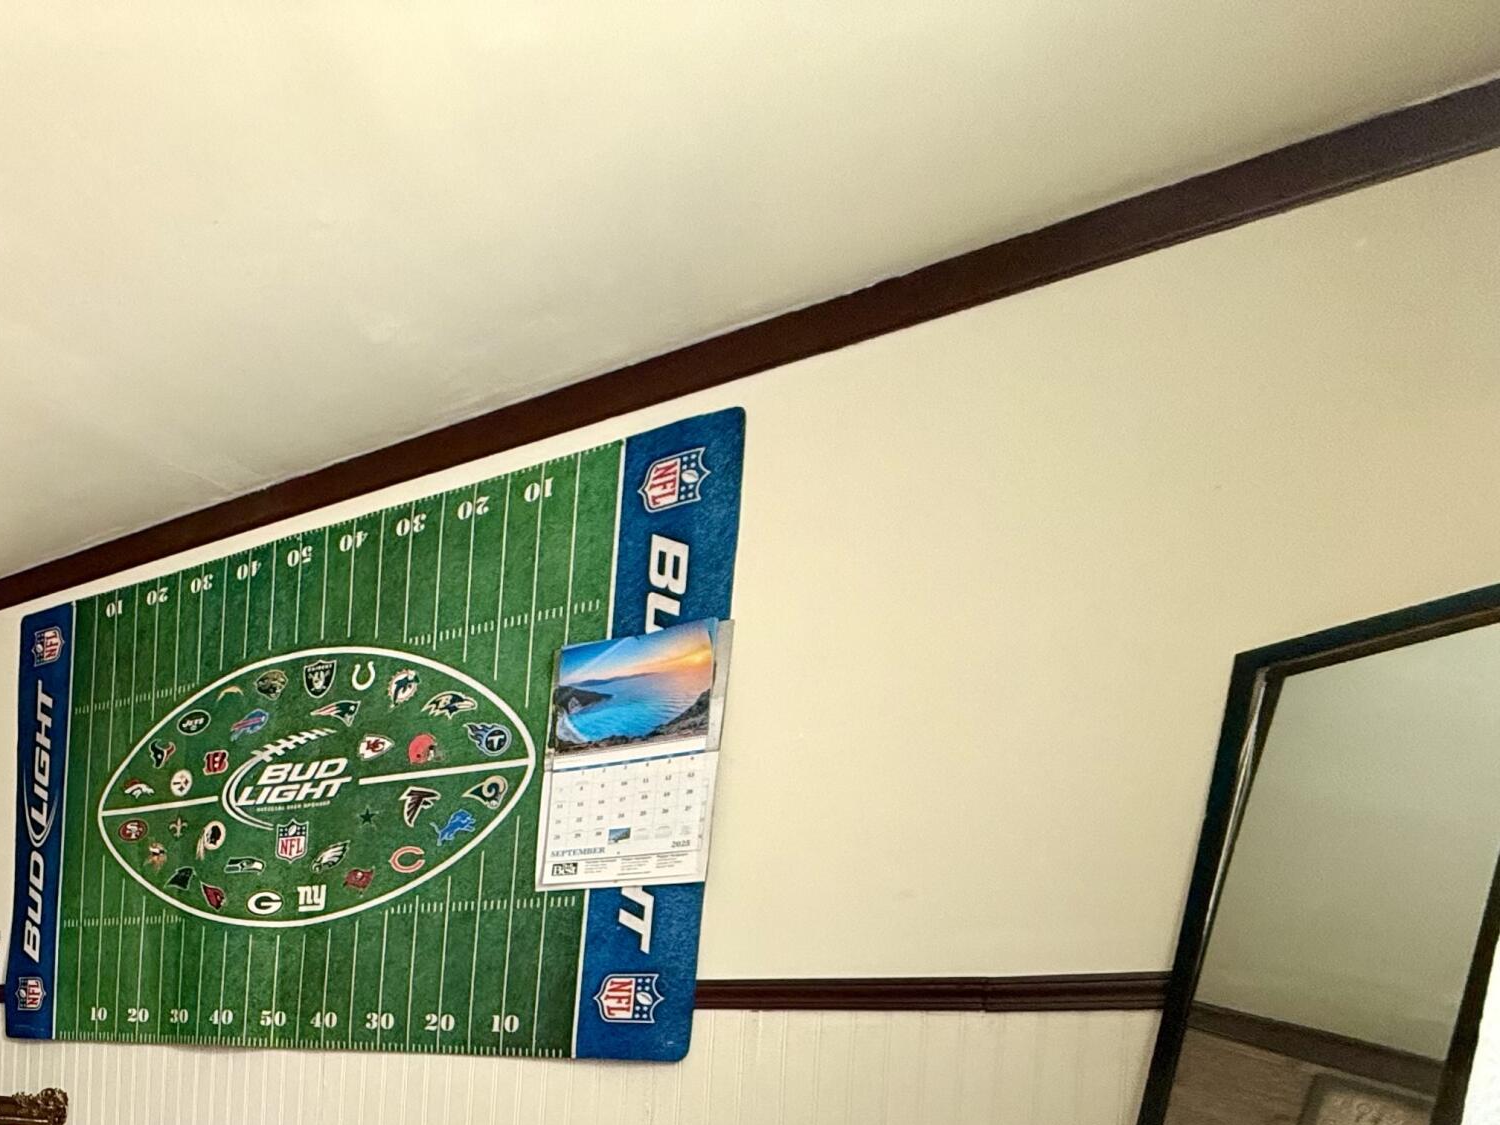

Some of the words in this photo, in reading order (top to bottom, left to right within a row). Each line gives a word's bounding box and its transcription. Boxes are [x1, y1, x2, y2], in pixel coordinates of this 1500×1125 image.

[651, 460, 678, 506] NFL
[106, 599, 123, 618] 10
[147, 586, 169, 605] 20
[190, 574, 213, 593] 30
[237, 560, 262, 581] 40
[287, 545, 313, 567] 50
[339, 530, 368, 552] 40
[396, 513, 427, 536] 30
[457, 496, 490, 520] 20
[523, 477, 554, 502] 10
[45, 631, 59, 658] NFL
[30, 679, 53, 828] LIGHT
[257, 758, 348, 785] BUD
[236, 776, 352, 806] LIGHT
[280, 838, 303, 856] NFL
[551, 847, 605, 858] SEPTEMBER
[671, 839, 690, 849] 2025
[24, 850, 45, 964] BUD
[247, 891, 283, 915] G
[27, 981, 40, 1006] NFL
[604, 980, 633, 1016] NFL
[90, 1007, 108, 1021] 10
[127, 1007, 149, 1023] 20
[169, 1008, 189, 1024] 30
[209, 1009, 233, 1025] 40
[260, 1011, 286, 1027] 50
[310, 1012, 337, 1029] 40
[365, 1013, 395, 1030] 30
[424, 1014, 455, 1032] 20
[490, 1015, 519, 1034] 10
